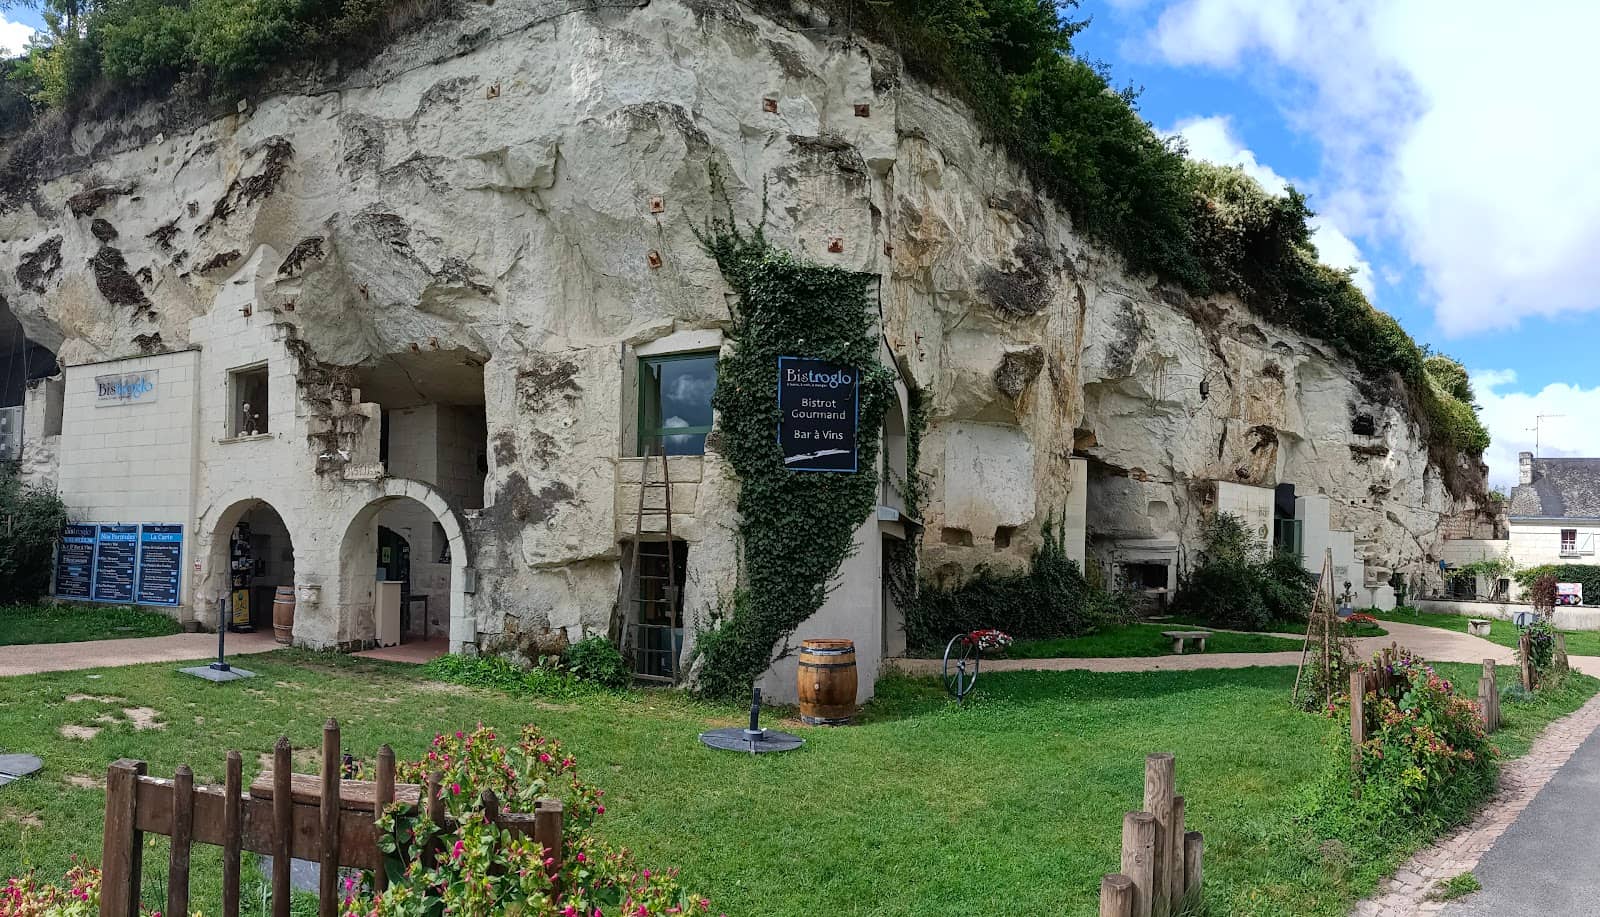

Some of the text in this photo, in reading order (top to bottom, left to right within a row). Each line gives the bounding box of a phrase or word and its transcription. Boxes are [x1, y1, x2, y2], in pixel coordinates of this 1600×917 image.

[787, 368, 852, 389] Bistroglo
[98, 375, 153, 399] Bistroglo
[801, 398, 837, 408] Bistrot
[791, 409, 846, 420] Gourmand
[794, 429, 844, 440] Bar à Vins
